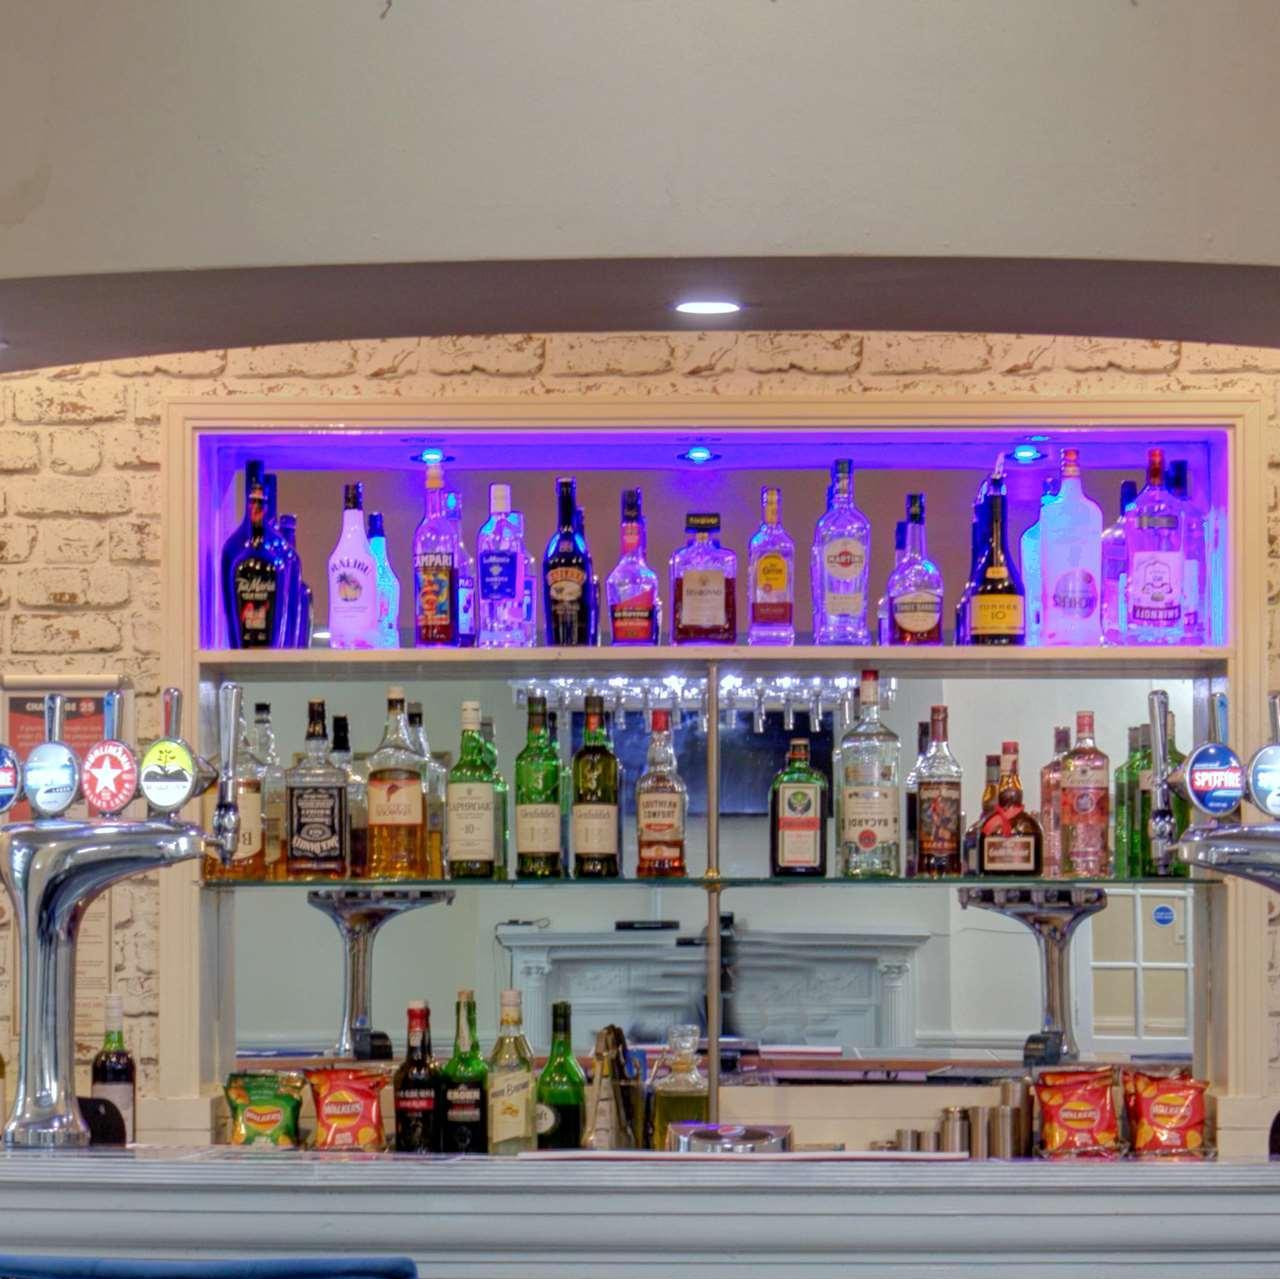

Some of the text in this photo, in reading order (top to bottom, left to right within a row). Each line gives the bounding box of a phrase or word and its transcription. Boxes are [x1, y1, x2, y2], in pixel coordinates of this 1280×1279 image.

[415, 554, 453, 568] AMPARI
[25, 702, 95, 711] CHAGE 25
[1195, 771, 1241, 787] SPITFIRE
[642, 801, 677, 809] SOUTHERN
[643, 810, 675, 819] COMFORT
[325, 1102, 363, 1115] WALKERS
[1152, 1103, 1191, 1115] WALKERS
[245, 1110, 282, 1122] WALKERS
[1060, 1110, 1099, 1121] WALKERS
